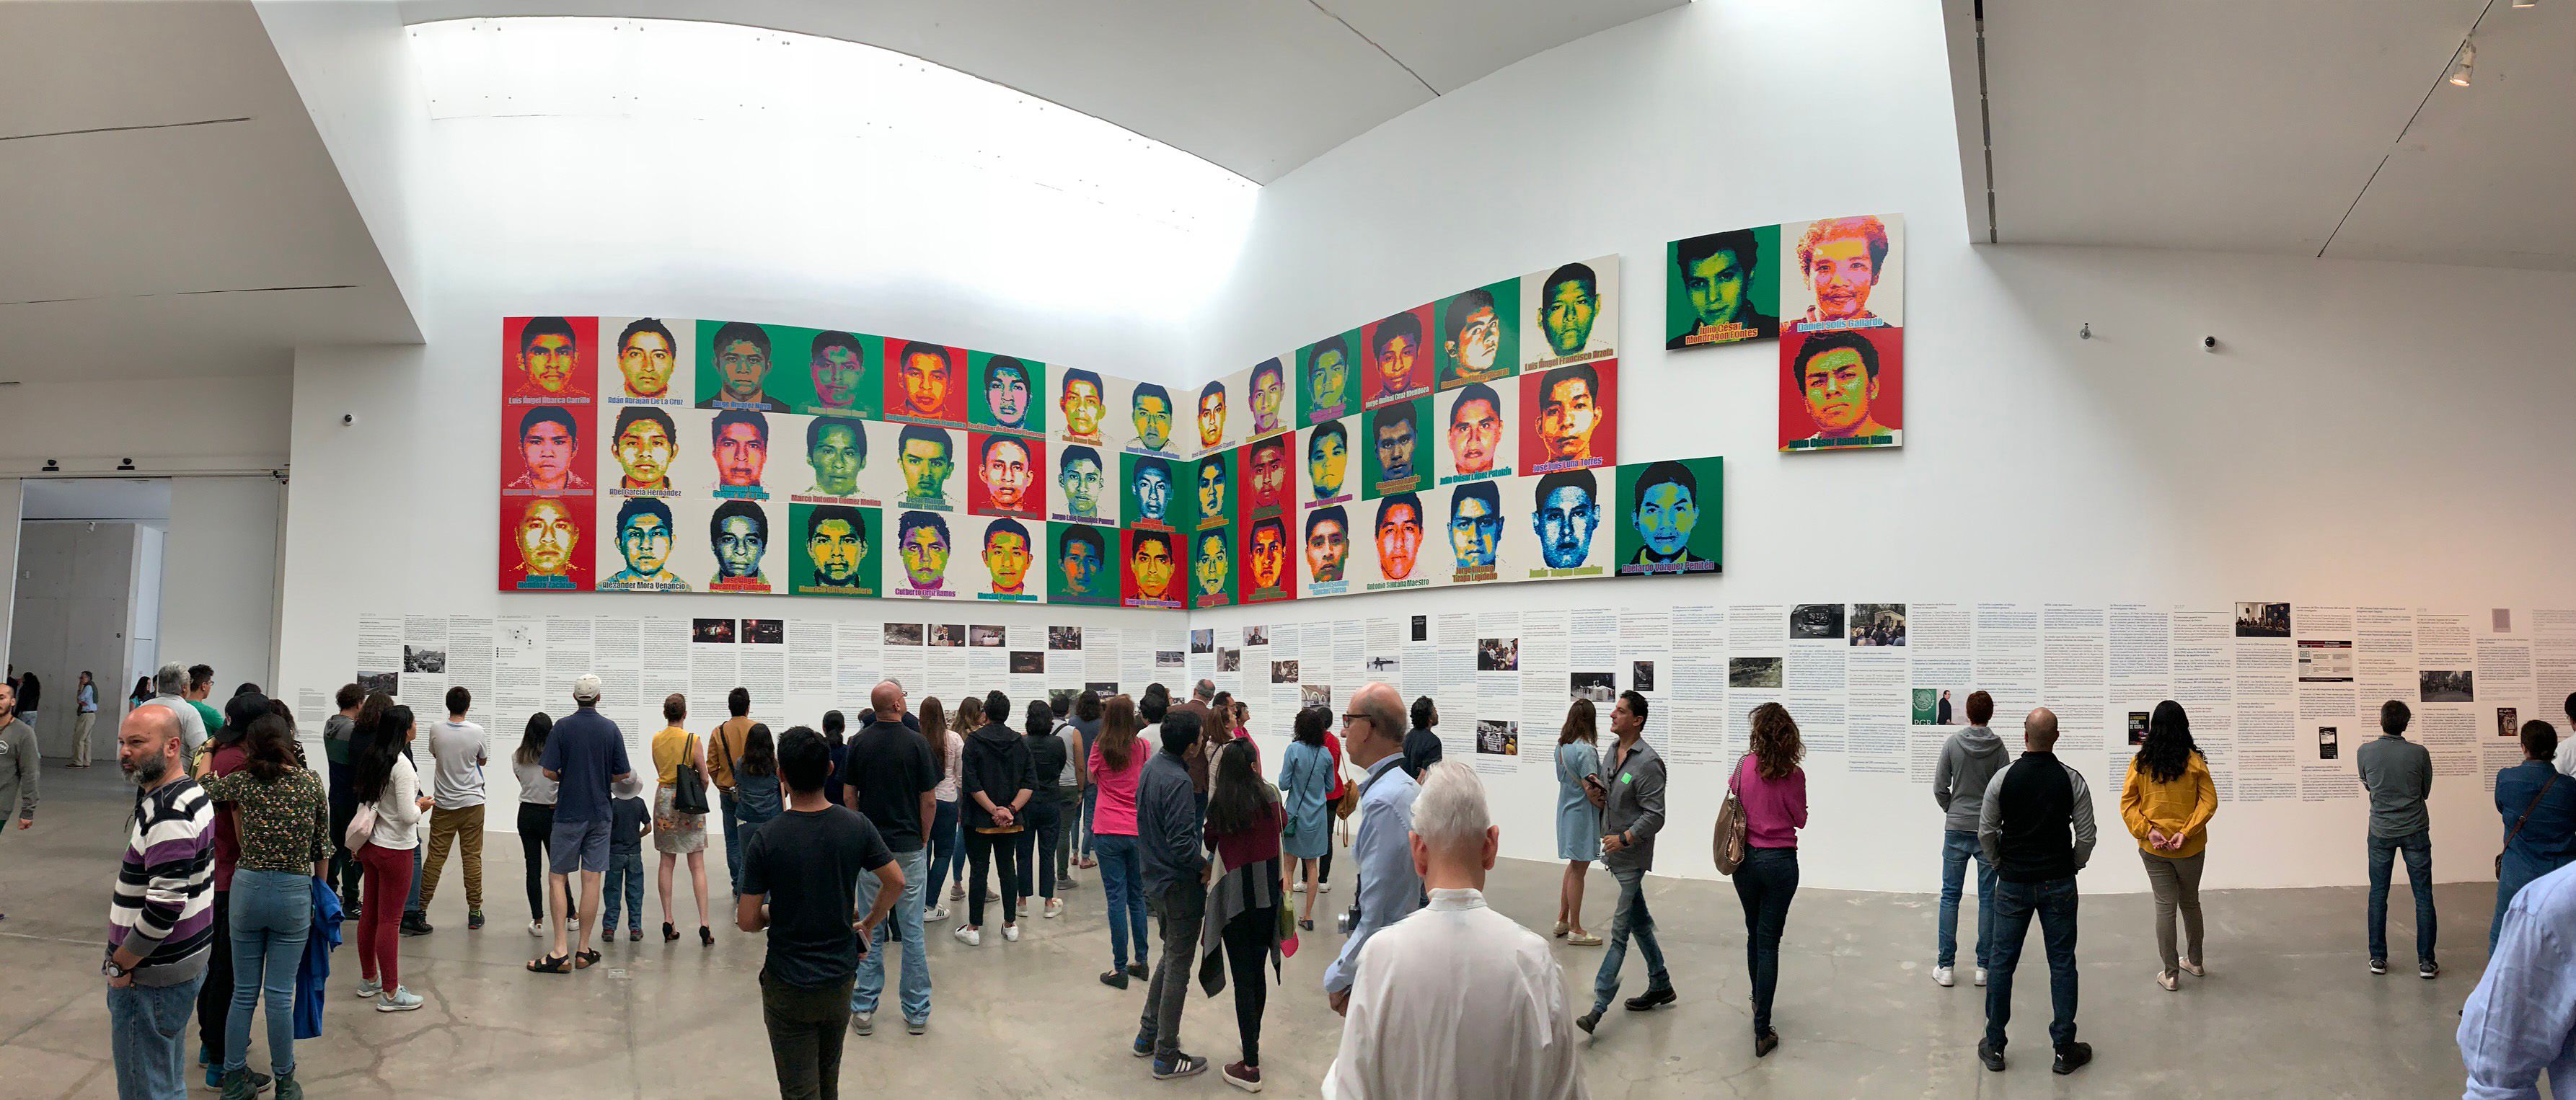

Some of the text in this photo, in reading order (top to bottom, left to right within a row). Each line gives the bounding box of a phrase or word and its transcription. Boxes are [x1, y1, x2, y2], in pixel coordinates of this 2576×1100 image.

[1698, 321, 1742, 335] Julio César
[1797, 317, 1884, 332] Daniel Solís Gallardo
[1730, 328, 1758, 340] Fontes
[1525, 362, 1538, 371] Luis
[1559, 352, 1592, 366] Francisco
[1394, 392, 1406, 401] Cruz
[1406, 386, 1430, 398] Mendoza
[1533, 456, 1603, 473] José Luis Luna Torres
[623, 487, 646, 497] García
[646, 487, 682, 497] Hernández
[1621, 559, 1715, 574] Abelardo Vázquez Penitén
[602, 581, 635, 590] Alexander
[1367, 578, 1429, 590] Antonio Santana Maestro
[895, 587, 922, 596] Cutberto
